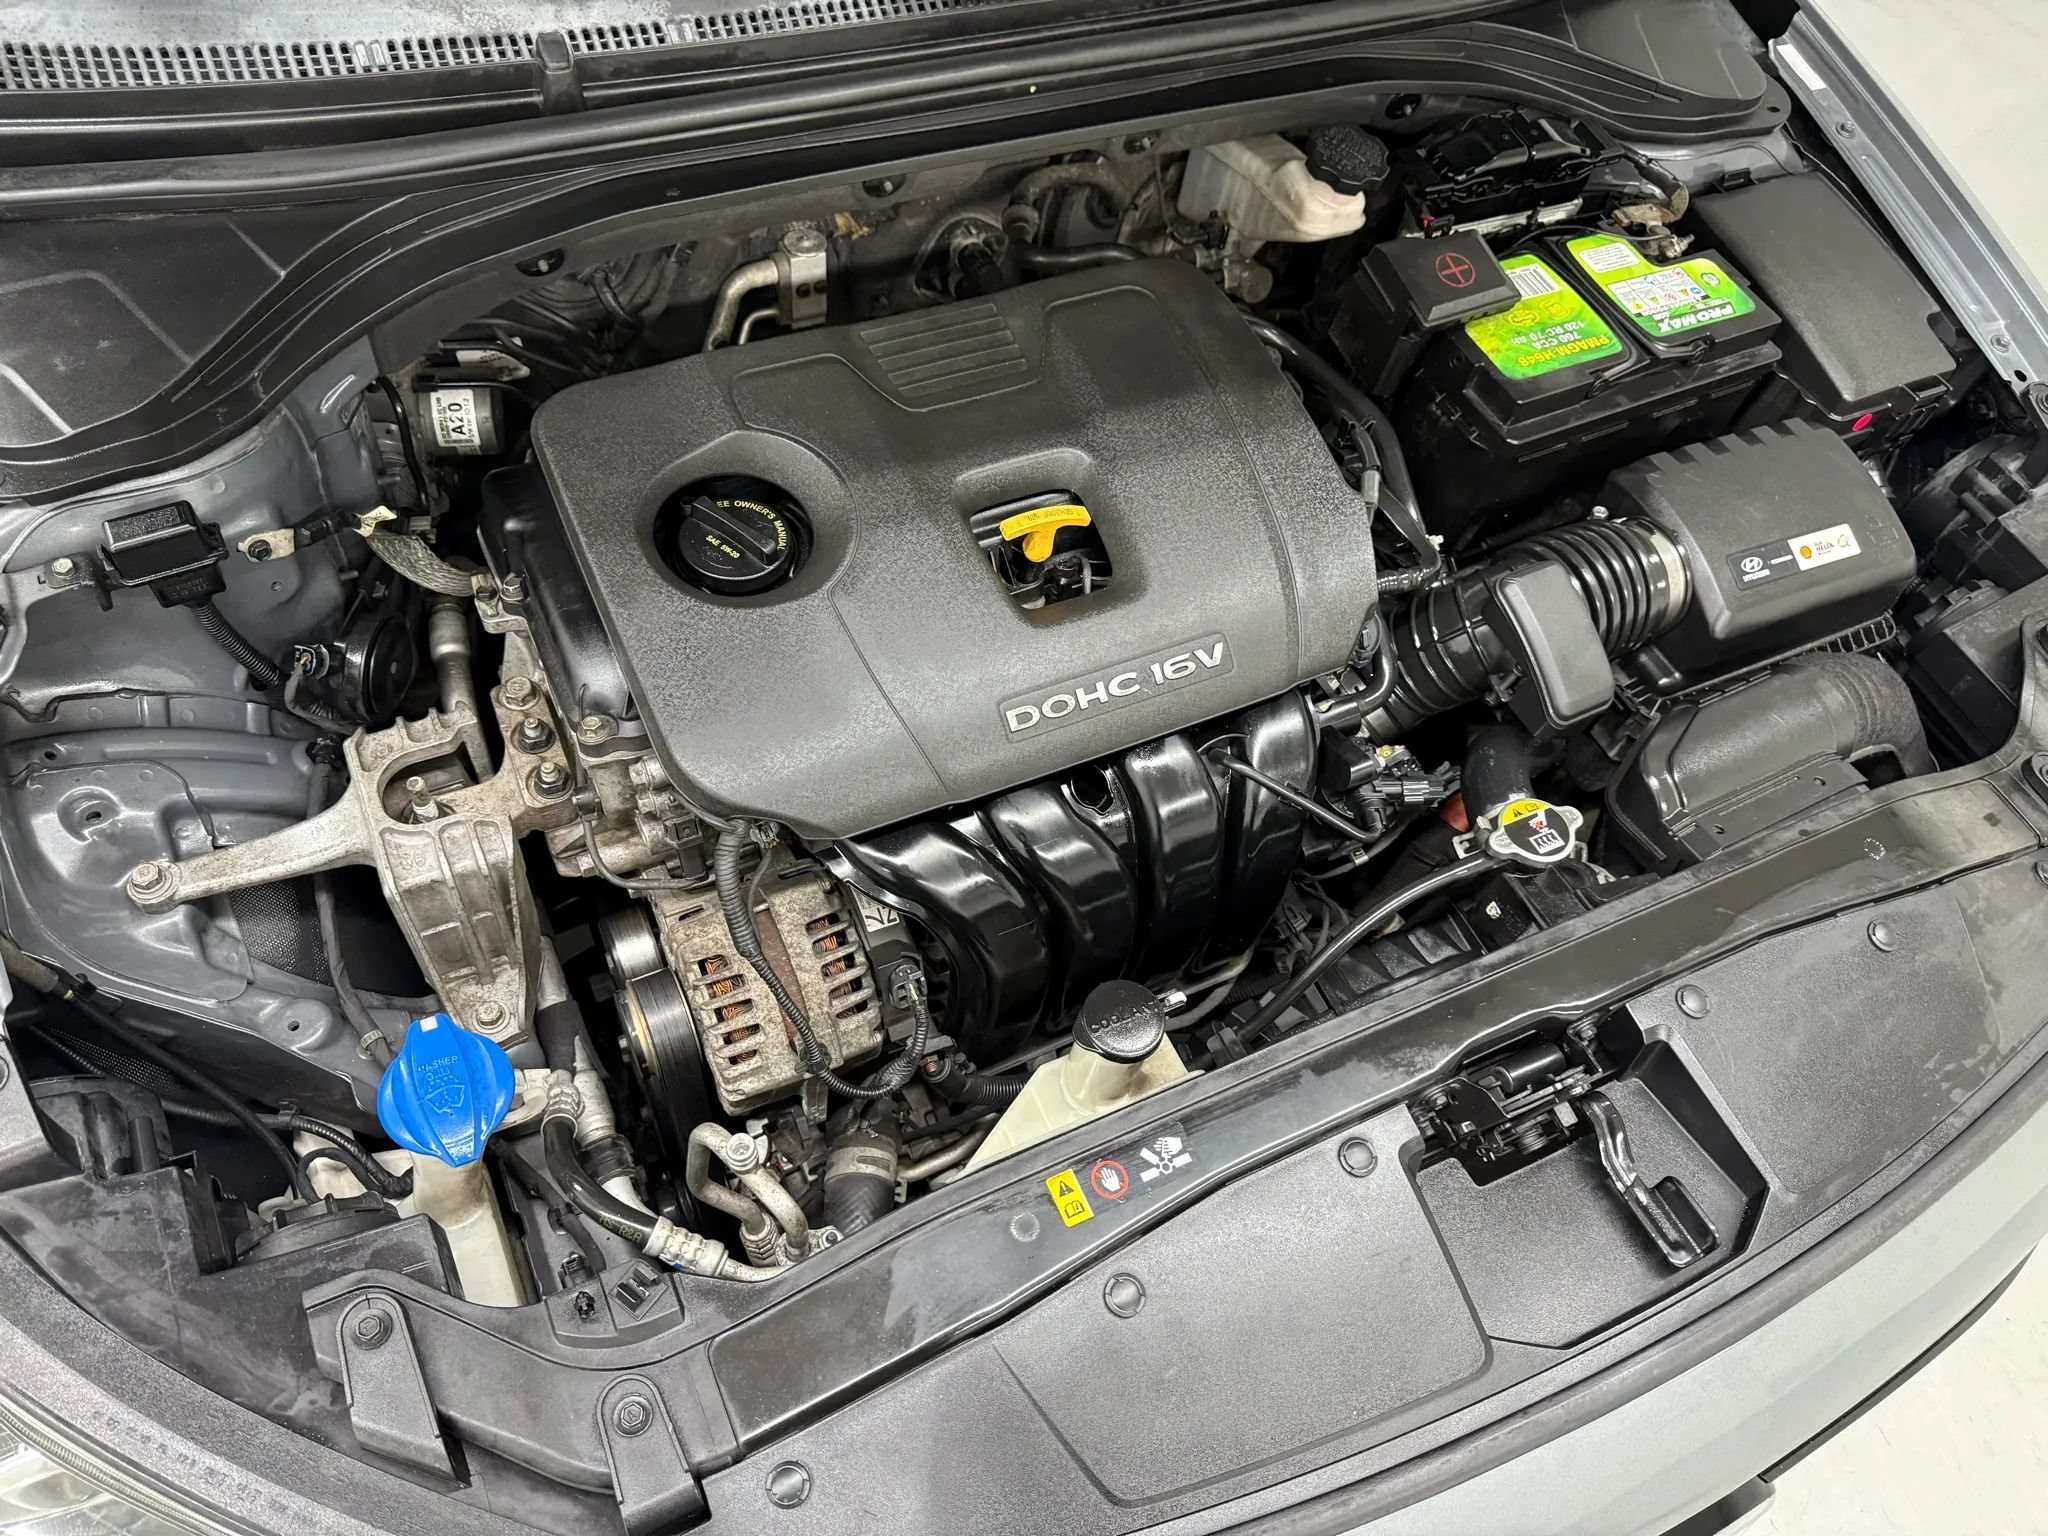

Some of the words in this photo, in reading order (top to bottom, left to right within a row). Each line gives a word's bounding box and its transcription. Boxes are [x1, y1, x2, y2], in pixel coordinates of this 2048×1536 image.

[1545, 325, 1564, 337] RC
[1563, 320, 1585, 331] 120
[1529, 331, 1545, 341] 70
[1532, 338, 1558, 350] CCA
[448, 402, 466, 436] A20
[734, 500, 776, 520] OWNER'S
[773, 520, 788, 551] MANUAL
[705, 535, 721, 547] SAE
[1005, 672, 1141, 733] DOHC
[1149, 641, 1224, 685] 16V
[416, 1055, 458, 1073] WASHER
